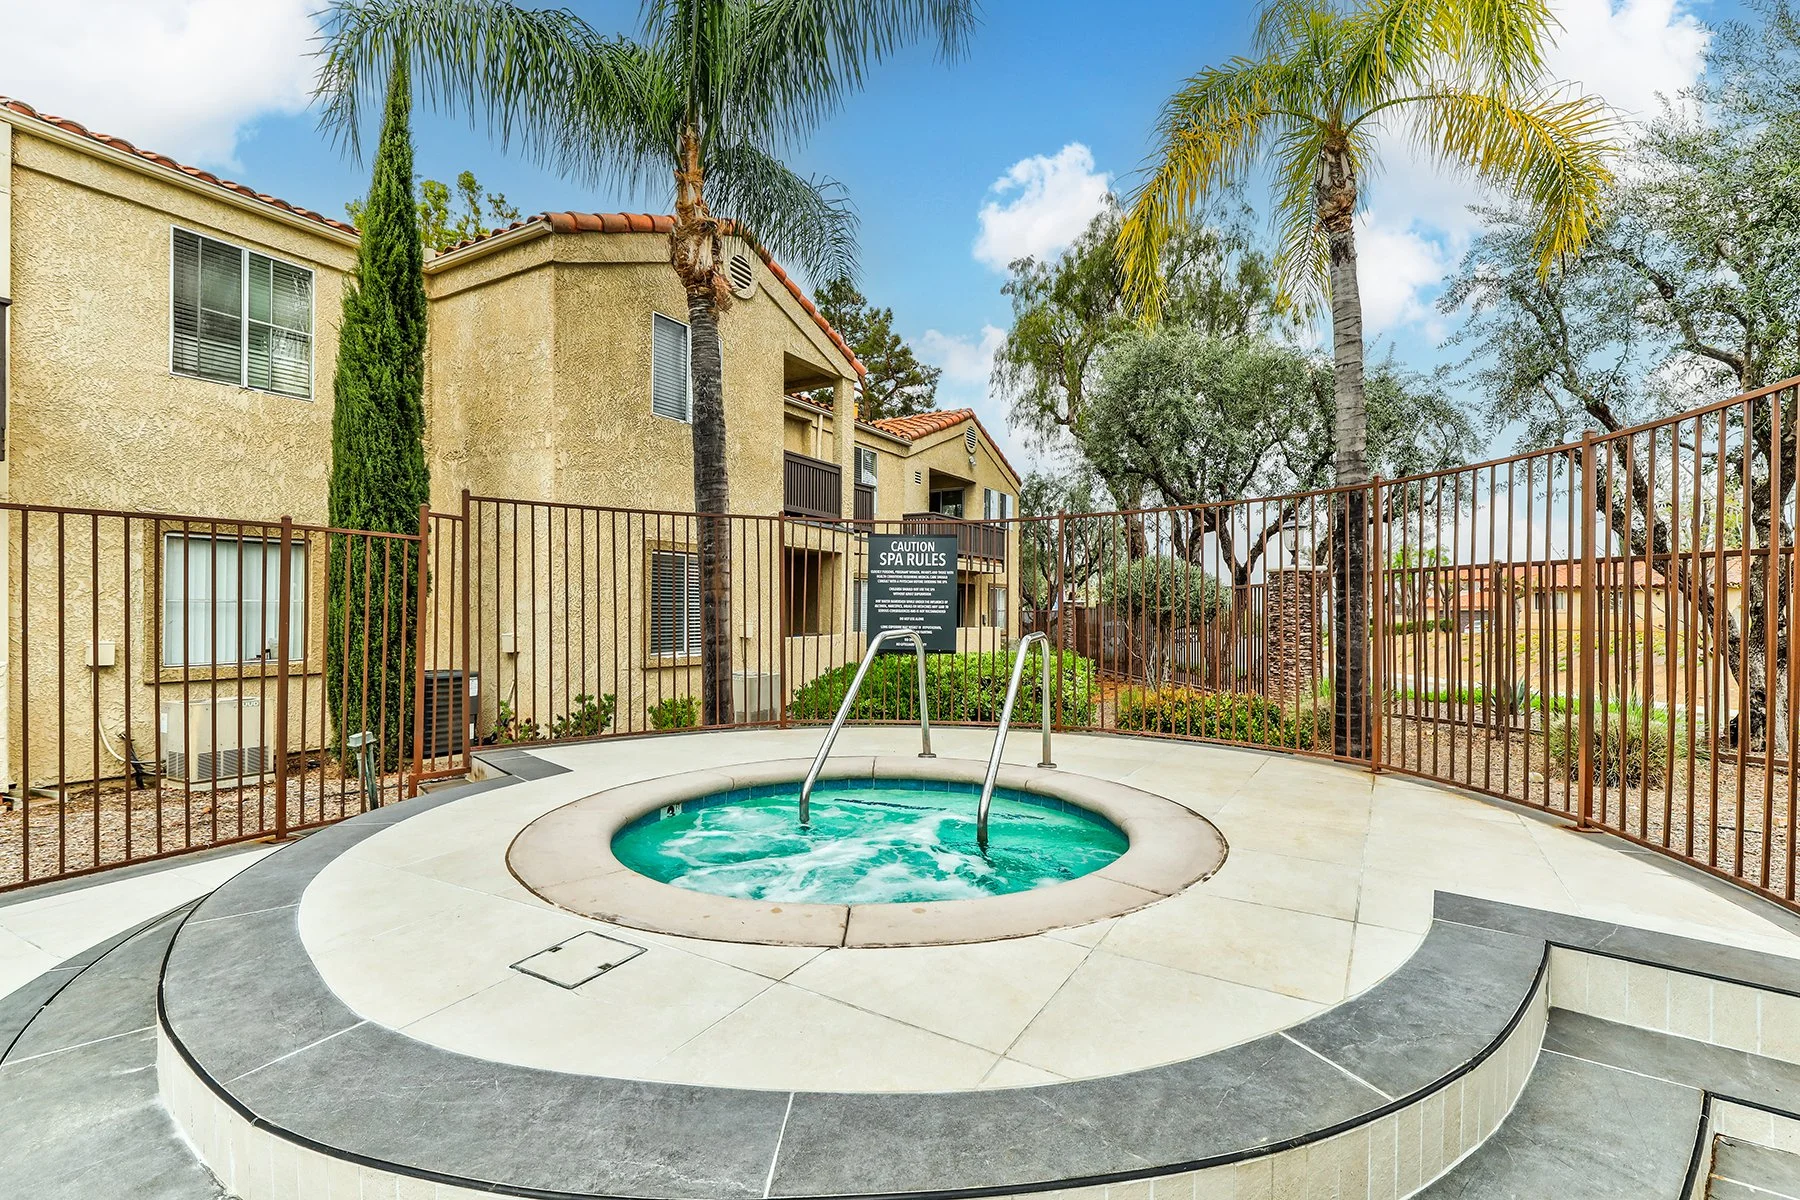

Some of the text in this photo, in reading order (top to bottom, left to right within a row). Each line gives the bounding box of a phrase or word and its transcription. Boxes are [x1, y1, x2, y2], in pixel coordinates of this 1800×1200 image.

[890, 541, 935, 552] CAUTION
[880, 552, 946, 566] SPA RULES
